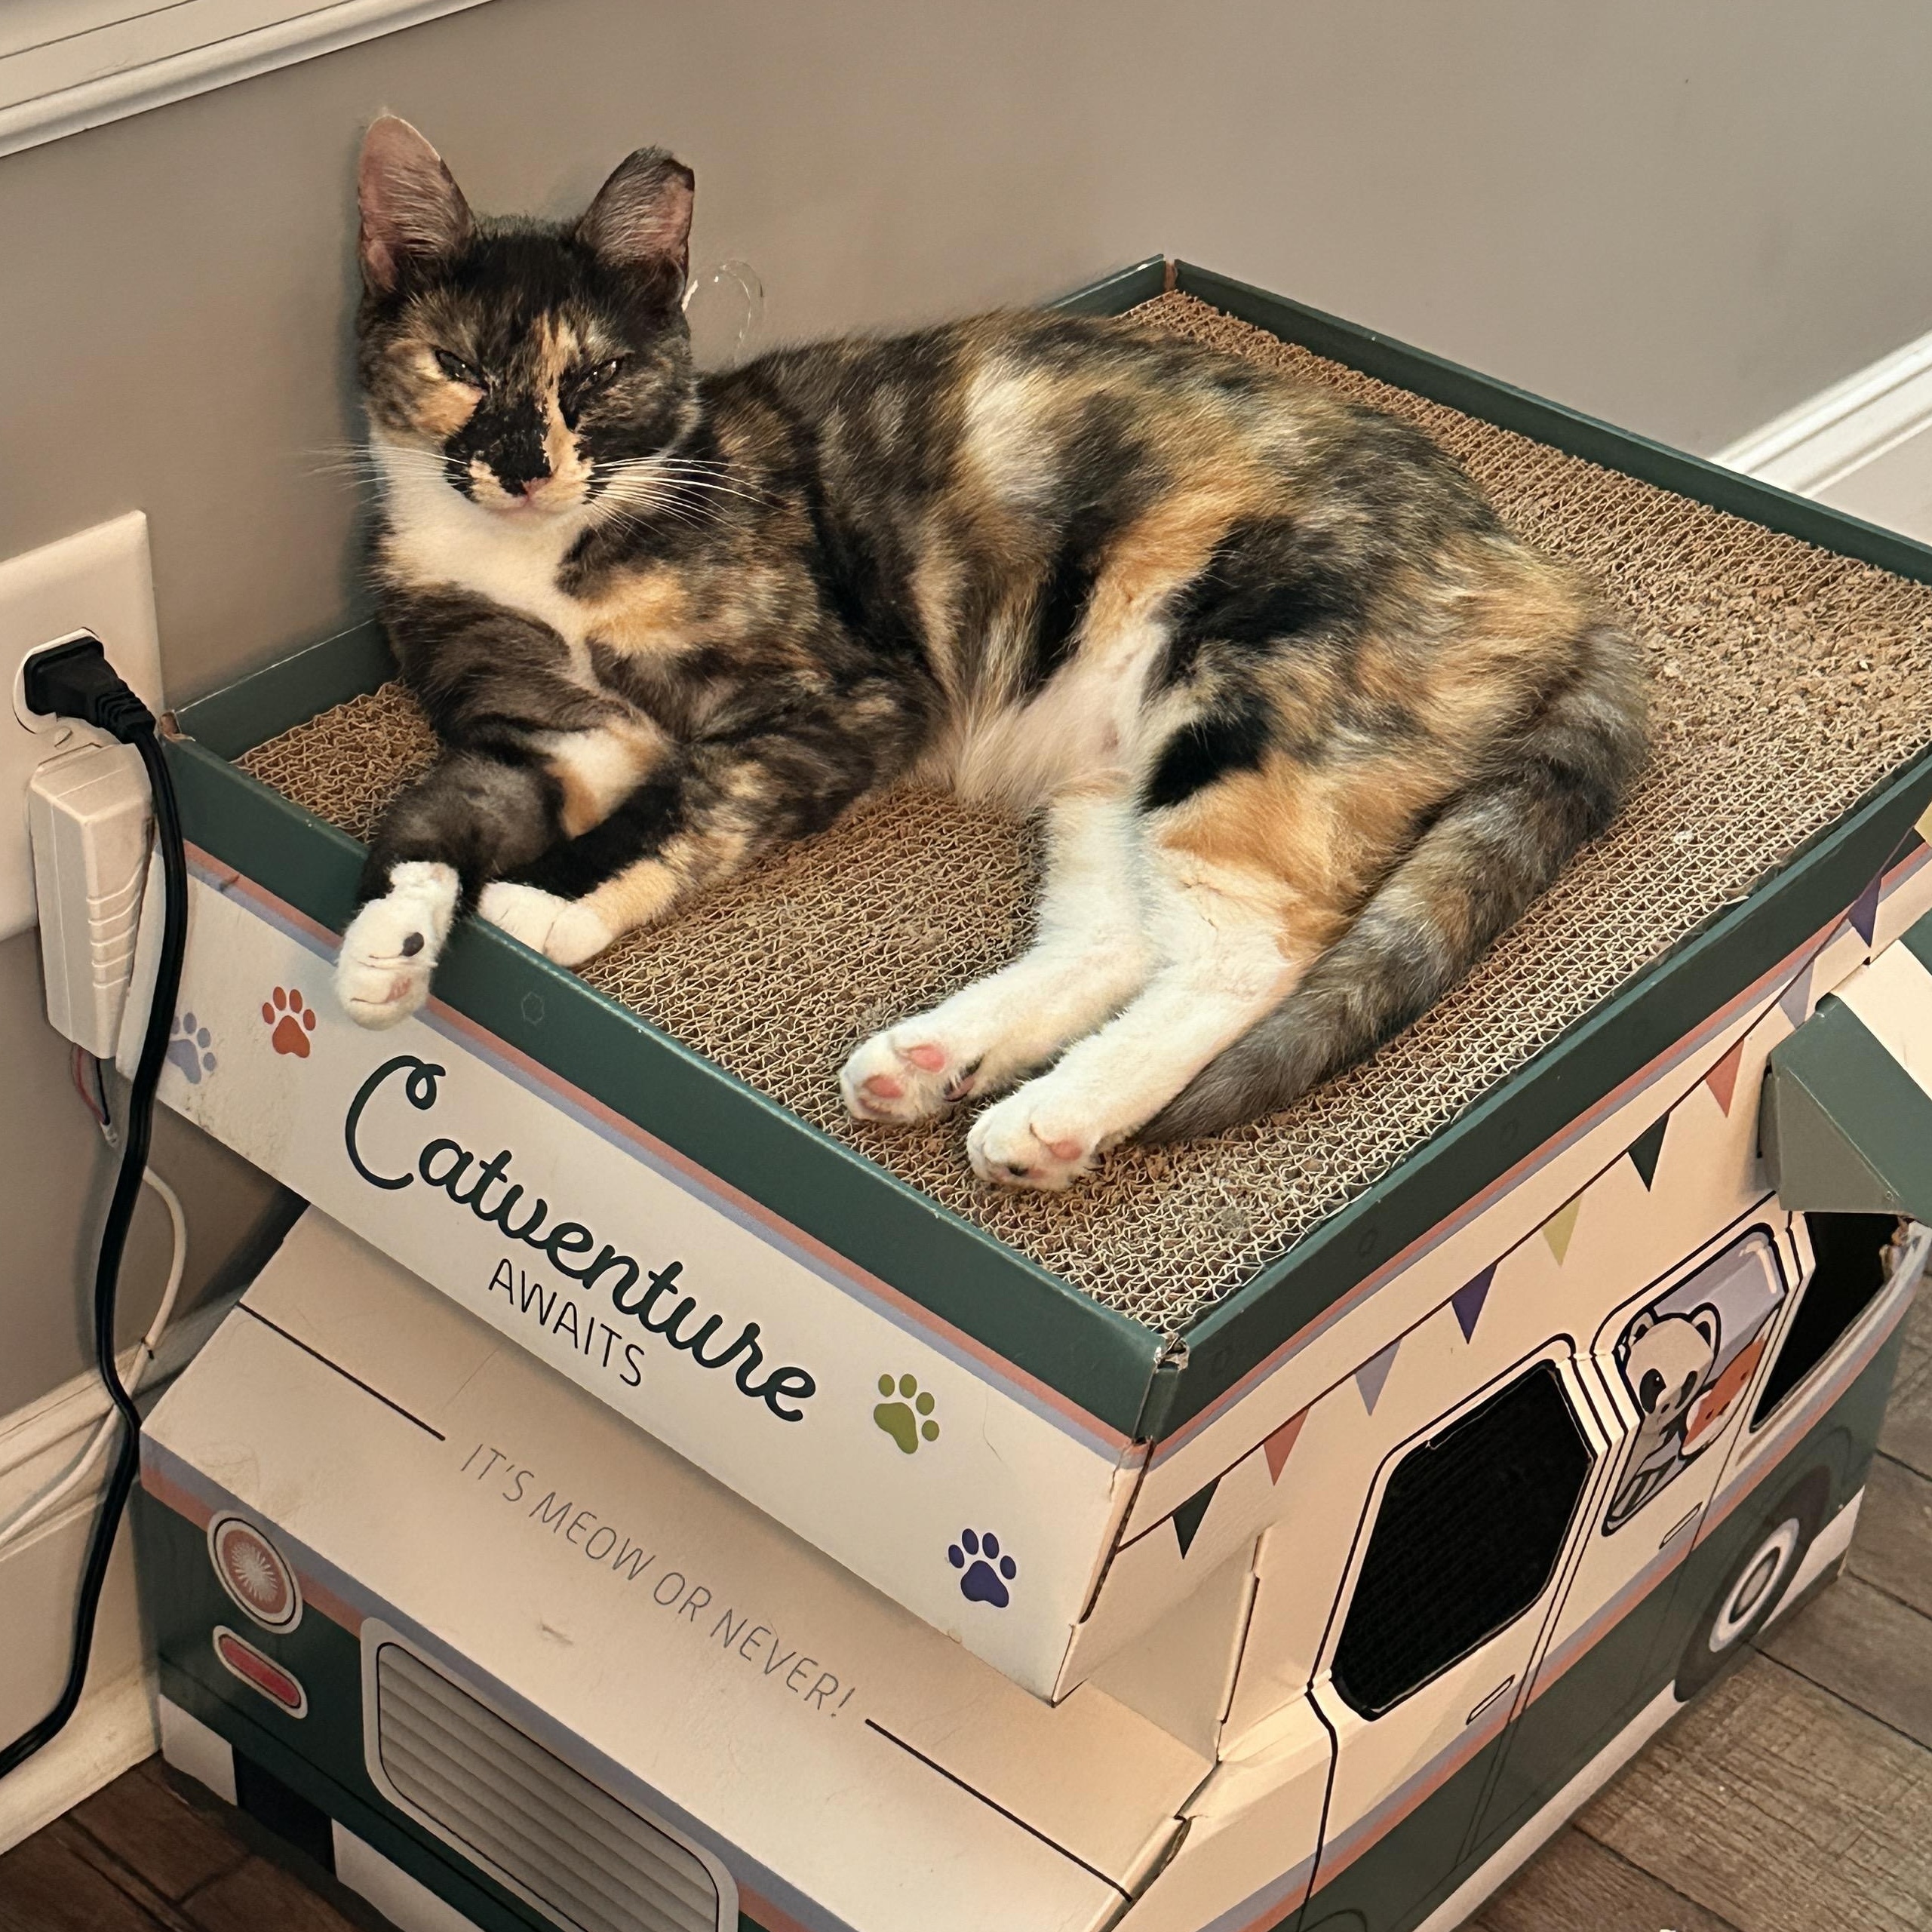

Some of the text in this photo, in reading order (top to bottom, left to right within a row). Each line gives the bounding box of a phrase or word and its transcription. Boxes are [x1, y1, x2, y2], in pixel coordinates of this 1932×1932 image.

[345, 1054, 816, 1423] Catventure
[487, 1258, 646, 1387] AWAITS
[460, 1442, 856, 1718] IT'S MEOW OR NEVER!
